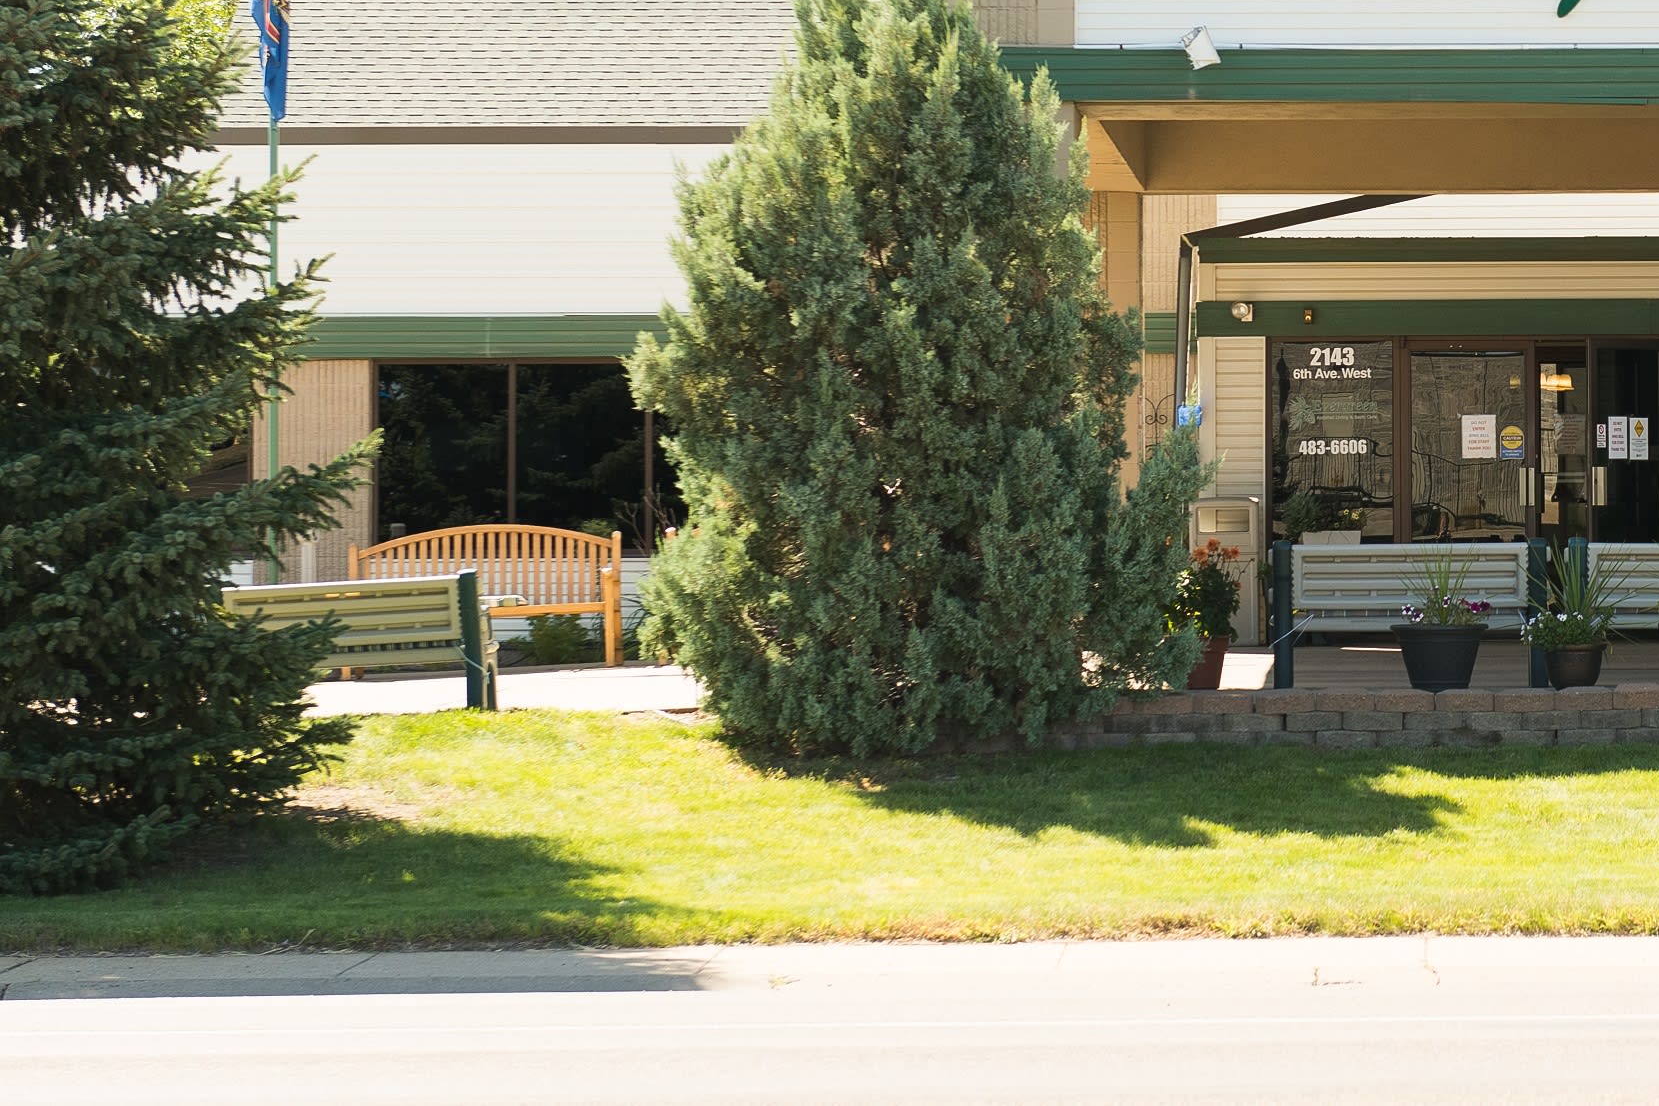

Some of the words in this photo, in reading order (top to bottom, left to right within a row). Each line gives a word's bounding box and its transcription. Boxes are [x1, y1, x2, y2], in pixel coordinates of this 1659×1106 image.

[1309, 347, 1355, 366] 2143
[1292, 368, 1312, 379] 6th
[1314, 368, 1341, 379] Ave.
[1341, 367, 1372, 379] West
[1298, 439, 1367, 455] 483-6606
